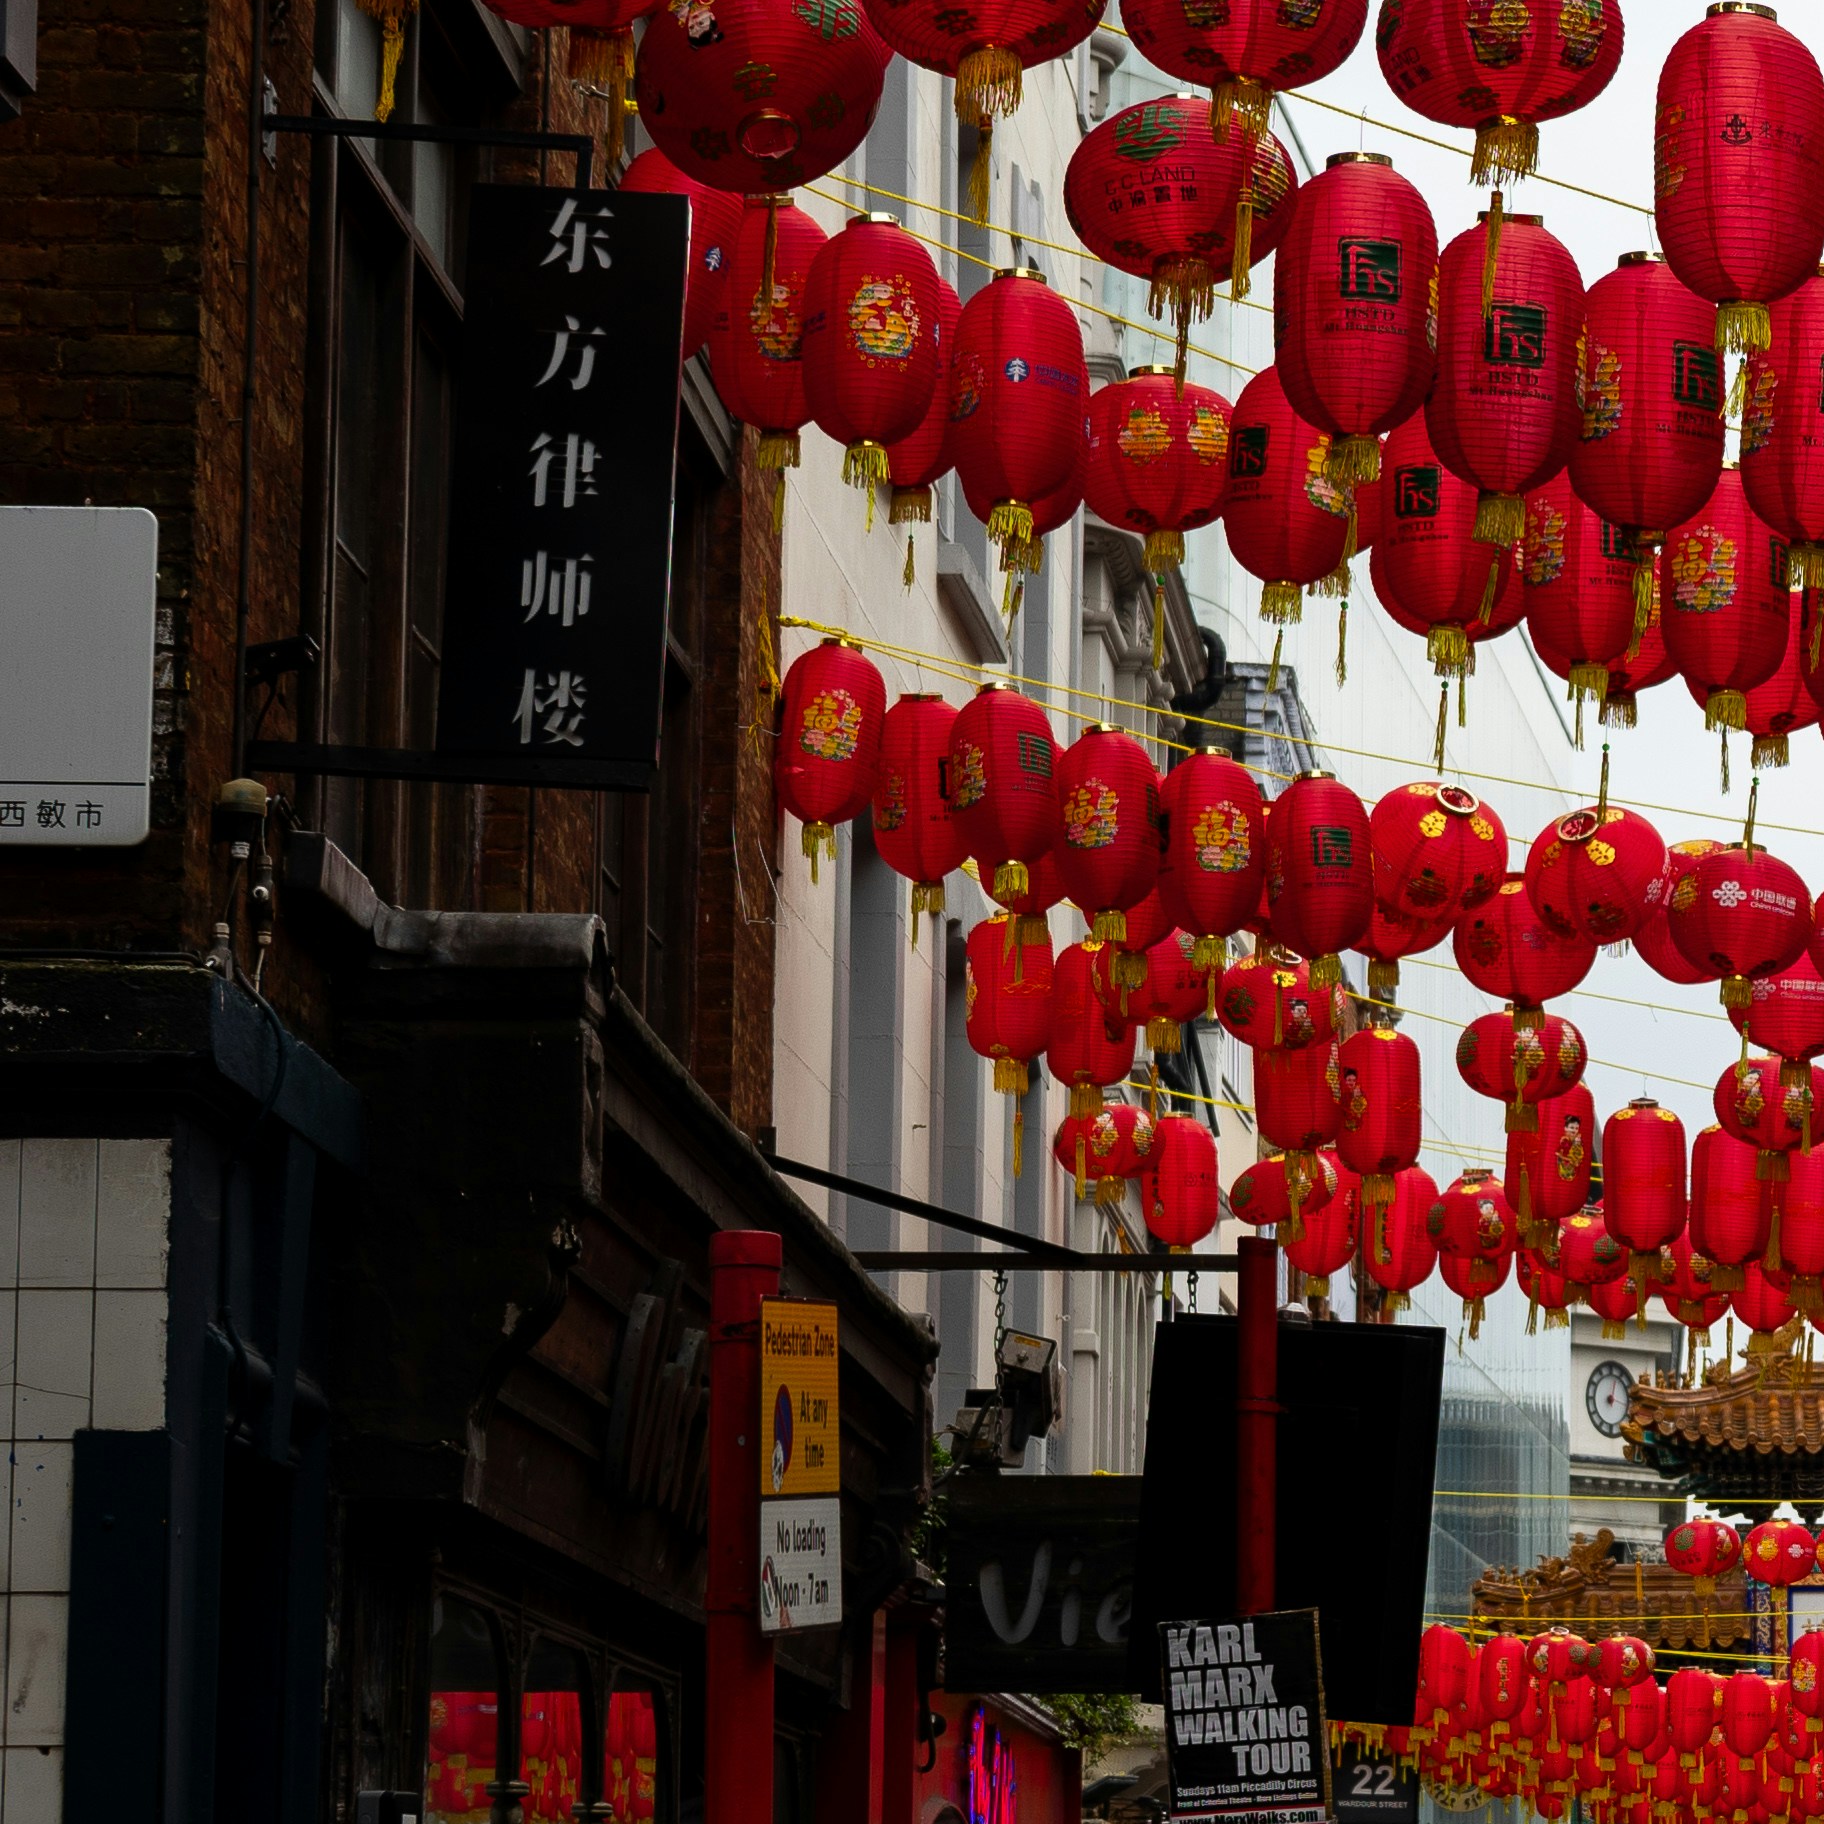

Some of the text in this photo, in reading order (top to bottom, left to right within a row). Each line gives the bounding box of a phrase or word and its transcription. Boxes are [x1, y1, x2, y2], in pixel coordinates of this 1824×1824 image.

[512, 197, 615, 747] 东方律师楼
[0, 799, 104, 829] 西敏市
[765, 1321, 836, 1358] Pedestrian Zone
[800, 1390, 828, 1428] At any
[805, 1439, 825, 1469] time
[776, 1520, 826, 1556] No loading
[774, 1576, 800, 1608] Noon
[808, 1572, 829, 1605] 7am
[1167, 1622, 1262, 1668] KARL
[1170, 1664, 1278, 1711] MARX
[1173, 1705, 1309, 1746] WALKING
[1232, 1741, 1311, 1777] TOUR
[1177, 1784, 1216, 1798] Sundays
[1240, 1779, 1286, 1794] Piccadilly
[1287, 1778, 1318, 1790] Circus
[1351, 1763, 1396, 1796] 22
[1378, 1800, 1408, 1809] STREET
